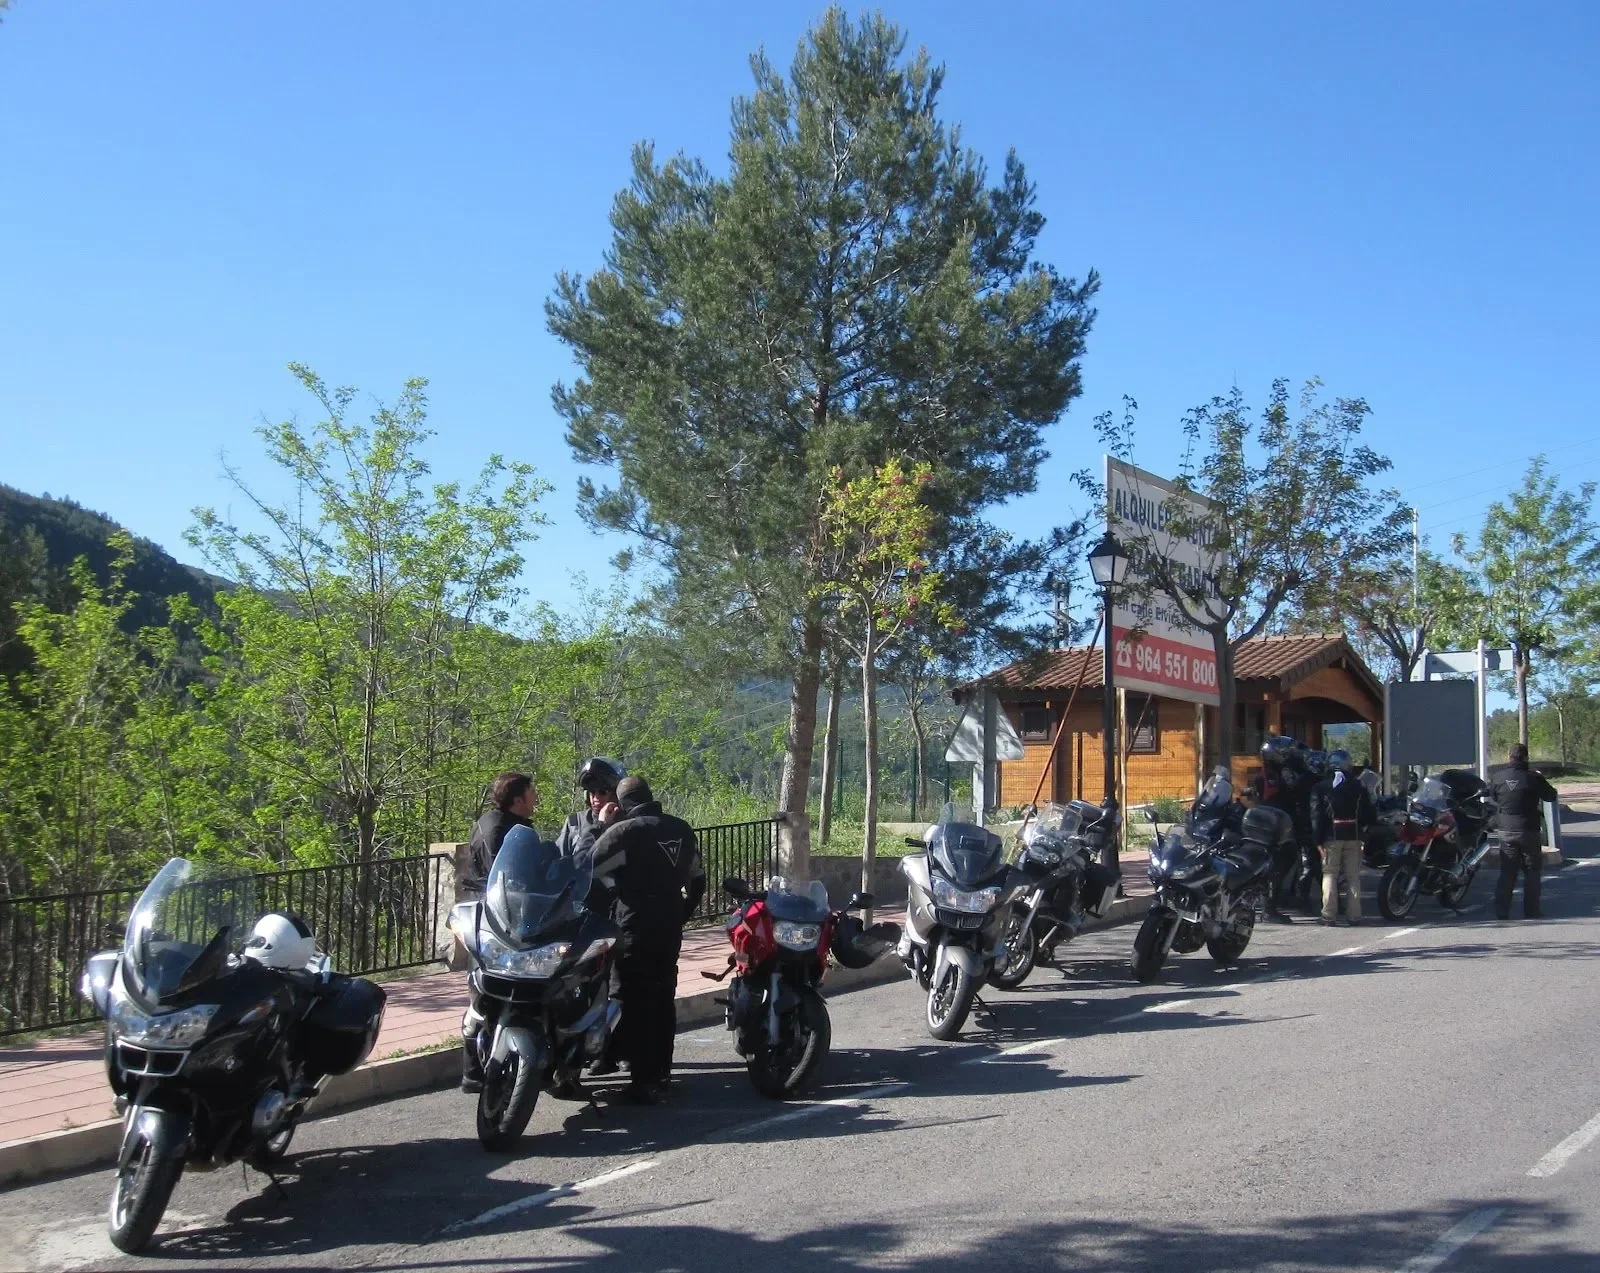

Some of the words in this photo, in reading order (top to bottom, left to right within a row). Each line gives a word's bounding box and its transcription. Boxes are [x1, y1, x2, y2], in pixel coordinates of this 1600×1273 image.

[1136, 644, 1161, 675] 964
[1165, 651, 1188, 681] 551
[1192, 658, 1216, 687] 800
